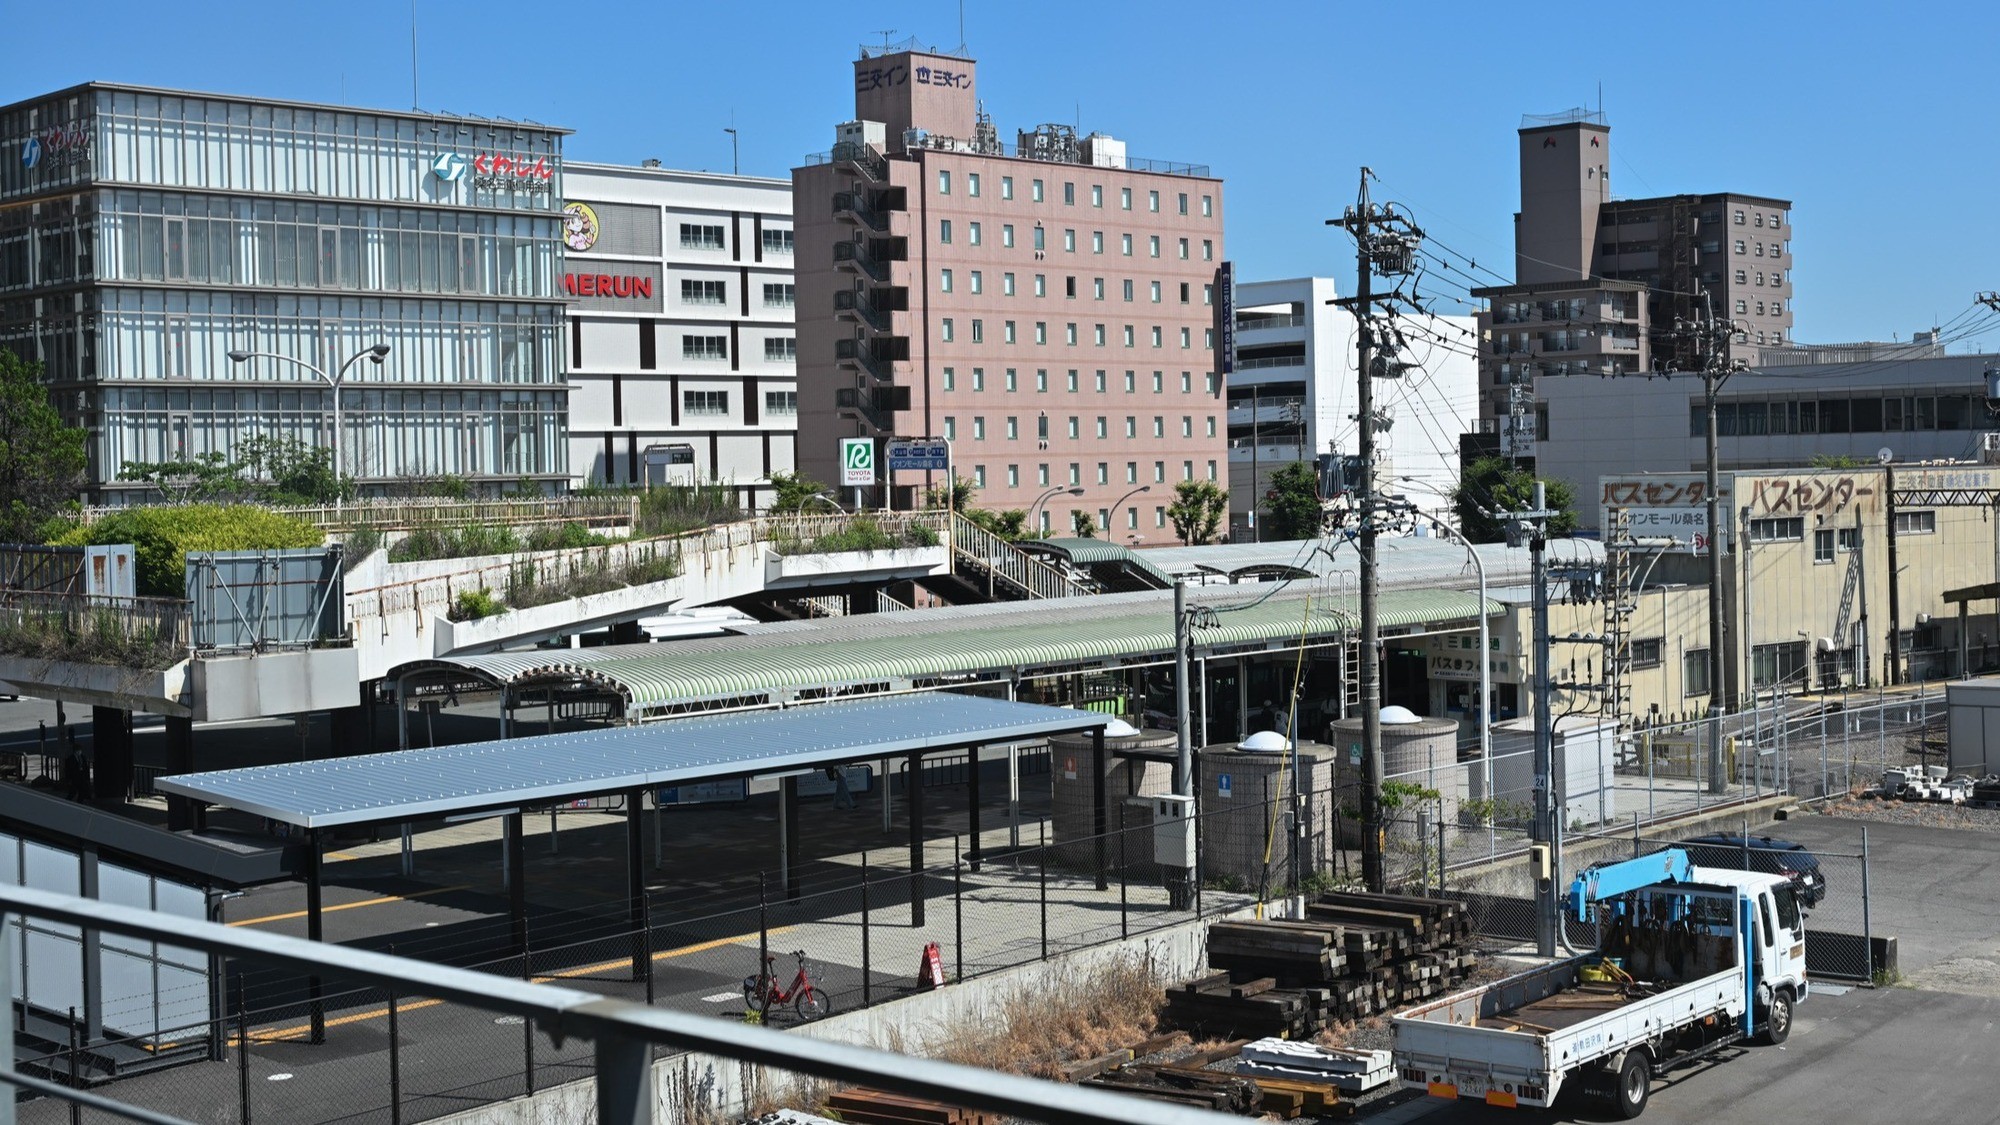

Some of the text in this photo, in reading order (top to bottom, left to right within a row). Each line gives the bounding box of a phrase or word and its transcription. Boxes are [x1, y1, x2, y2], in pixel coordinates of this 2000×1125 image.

[857, 66, 908, 92] 三交イン
[933, 70, 972, 89] 三交イン
[474, 151, 554, 179] くわしん
[1749, 477, 1873, 512] バスセンター
[1535, 777, 1545, 787] 24
